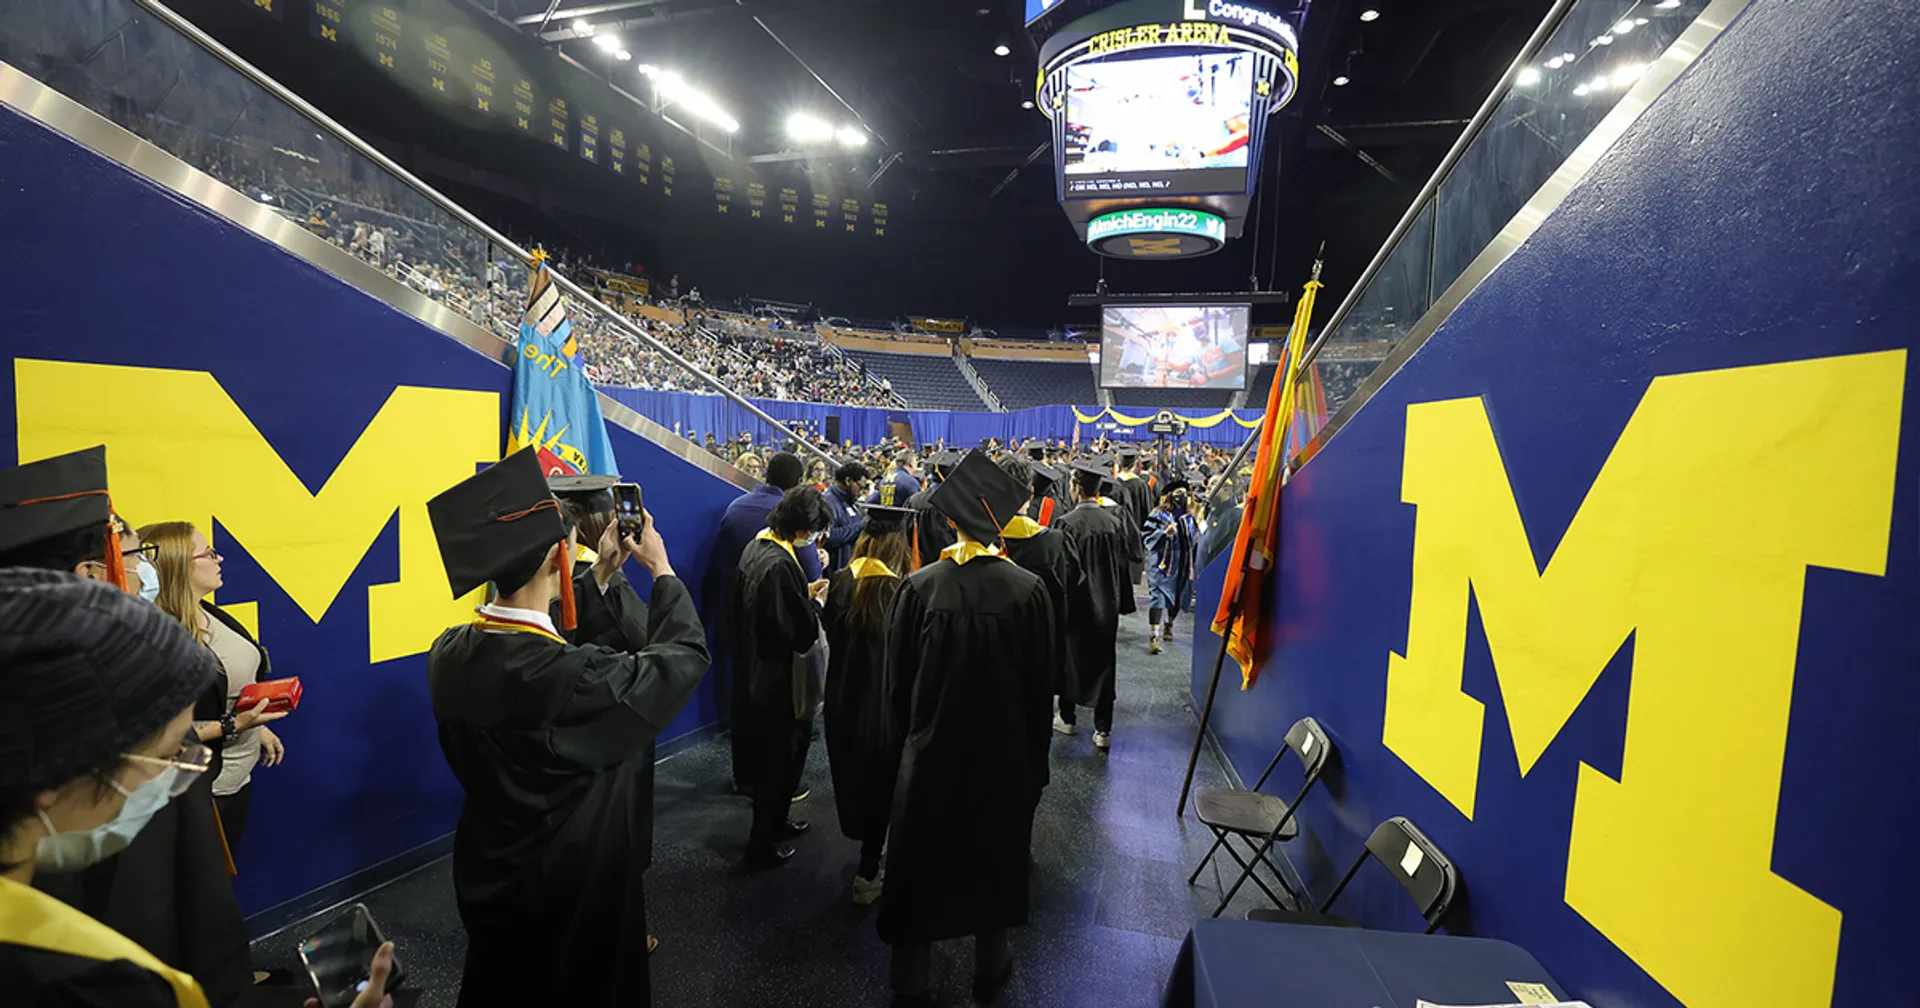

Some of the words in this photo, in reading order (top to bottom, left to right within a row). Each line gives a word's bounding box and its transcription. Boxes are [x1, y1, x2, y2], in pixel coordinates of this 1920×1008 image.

[1088, 24, 1160, 54] CRISLER
[1165, 22, 1231, 45] ARENA
[14, 358, 500, 664] M
[1383, 348, 1908, 1008] M
